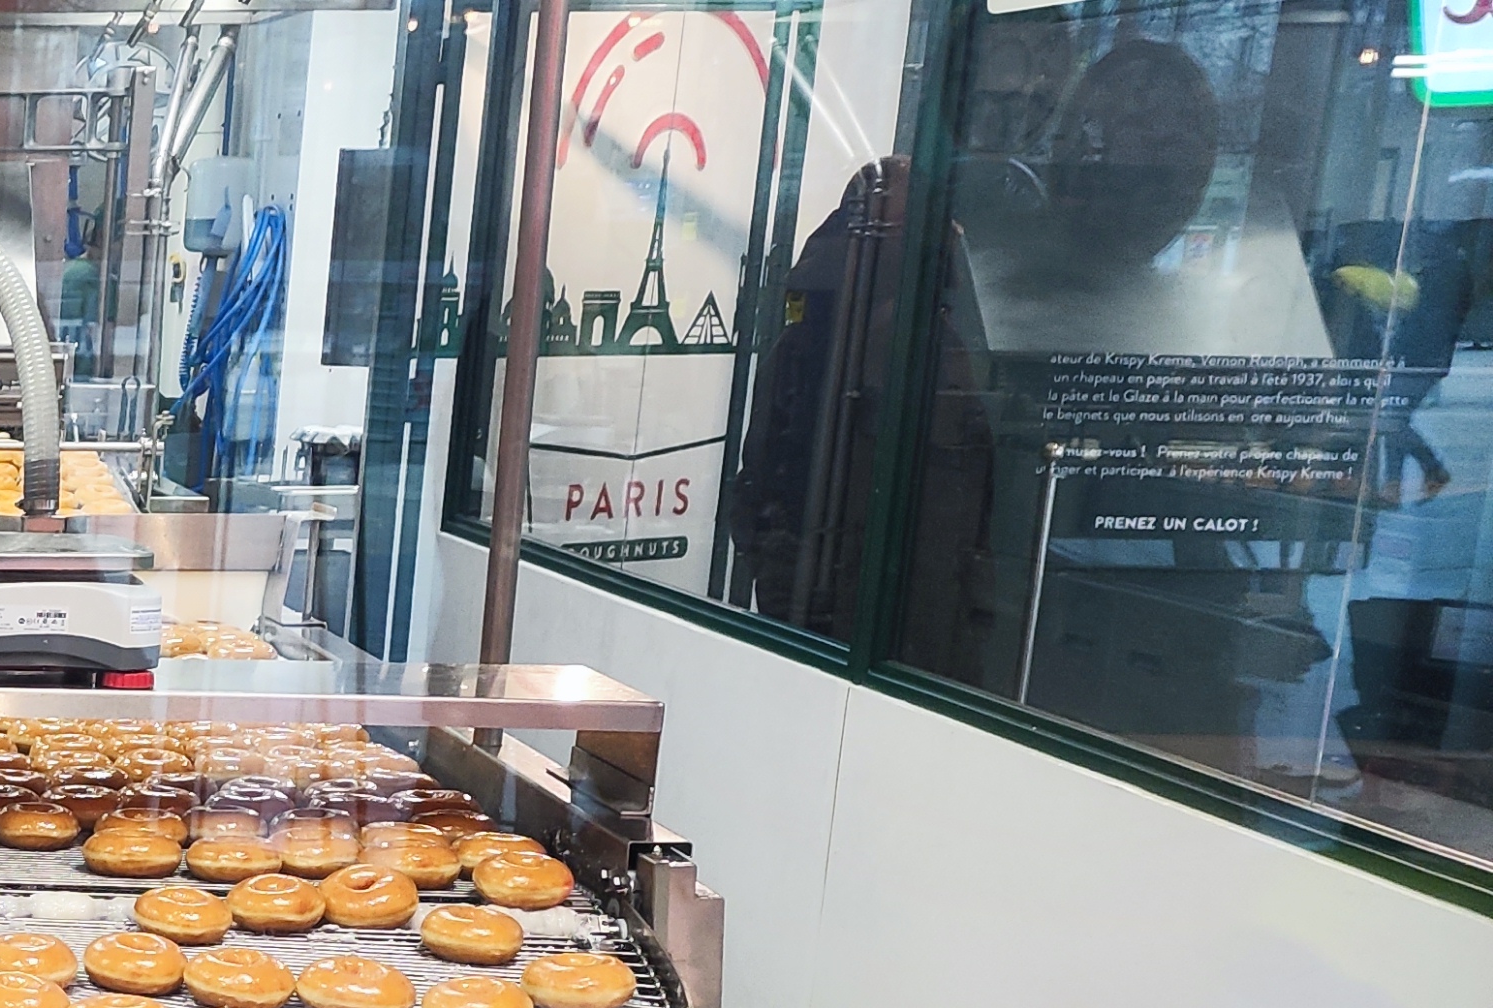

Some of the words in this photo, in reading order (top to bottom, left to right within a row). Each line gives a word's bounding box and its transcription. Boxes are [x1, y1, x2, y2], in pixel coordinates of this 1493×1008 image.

[1086, 352, 1101, 365] de
[1105, 352, 1145, 369] Krispy
[1148, 353, 1196, 368] Kreme,
[1200, 354, 1246, 367] Vernon
[1248, 355, 1307, 371] Rudolph,
[1054, 375, 1069, 383] un
[1128, 375, 1143, 384] en
[1146, 371, 1185, 388] papier
[1191, 376, 1205, 385] au
[1208, 373, 1248, 386] travail
[1250, 373, 1258, 386] à
[1292, 374, 1325, 387] 1937,
[1364, 373, 1391, 390] quil
[1060, 388, 1089, 406] pâte
[1092, 392, 1105, 402] et
[1109, 388, 1120, 402] le
[1123, 389, 1160, 403] Glaze
[1162, 390, 1170, 403] à
[1173, 390, 1184, 403] la
[1187, 393, 1218, 404] main
[1220, 394, 1251, 407] pour
[1254, 391, 1342, 408] perfectionner
[1345, 392, 1358, 405] la
[1360, 395, 1409, 408] reette
[1057, 407, 1110, 425] beignets
[1113, 412, 1137, 425] que
[1139, 411, 1170, 421] nous
[1174, 409, 1225, 422] utilisons
[1227, 413, 1272, 424] enore
[1275, 408, 1349, 427] aujourd'hui.
[1157, 445, 1200, 458] Prenez
[1203, 448, 1236, 459] votre
[1239, 449, 1282, 463] propre
[1285, 447, 1338, 463] chapeau
[1342, 448, 1358, 461] de
[1084, 466, 1097, 476] et
[1100, 463, 1163, 479] participez
[1169, 464, 1176, 476] à
[1179, 463, 1253, 481] l'expérience
[1257, 465, 1298, 482] Krispy
[1301, 466, 1344, 480] Kreme
[1347, 466, 1353, 480] !
[565, 477, 691, 522] PARIS
[1094, 516, 1156, 530] PRENEZ
[1163, 517, 1188, 531] UN
[1193, 517, 1249, 532] CALOT
[1252, 518, 1259, 532] !
